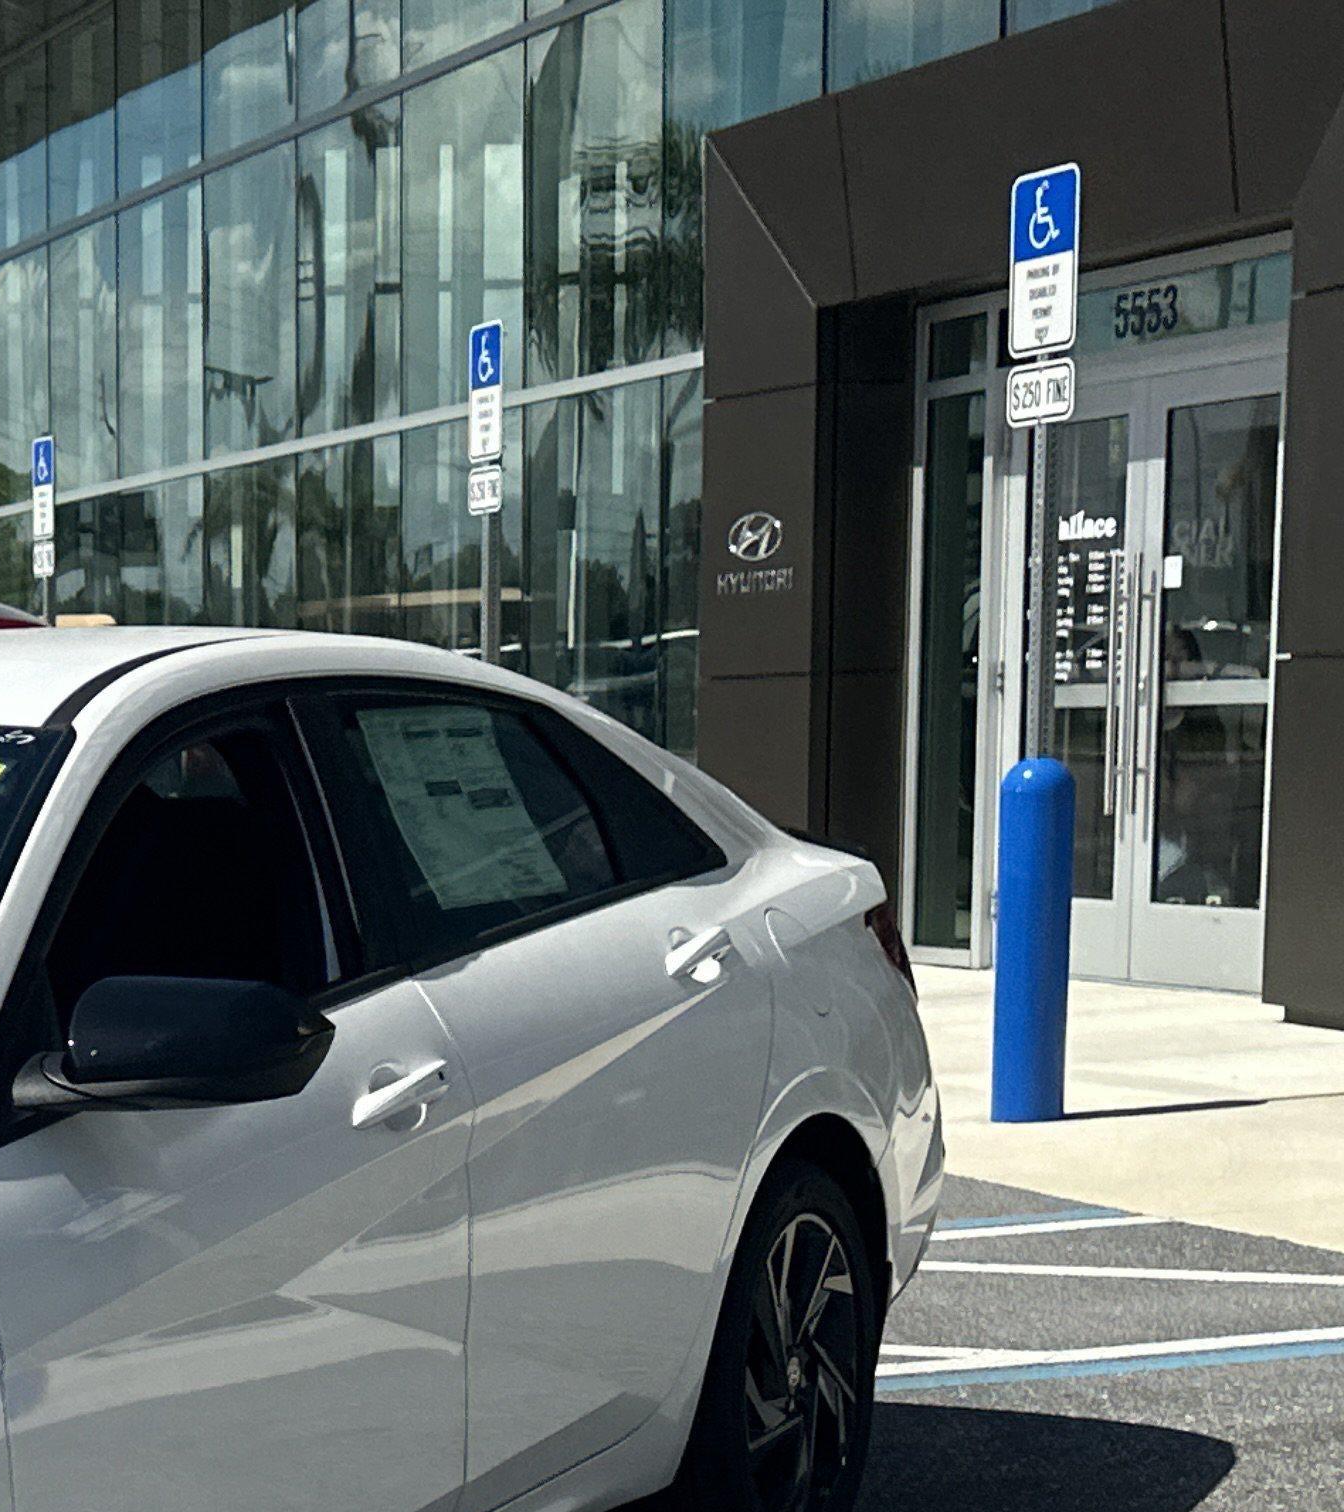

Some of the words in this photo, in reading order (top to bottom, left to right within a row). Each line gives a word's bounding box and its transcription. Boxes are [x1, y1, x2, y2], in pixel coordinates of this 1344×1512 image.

[1115, 284, 1178, 338] 5553
[1046, 376, 1068, 405] FINE
[1058, 510, 1117, 541] allace
